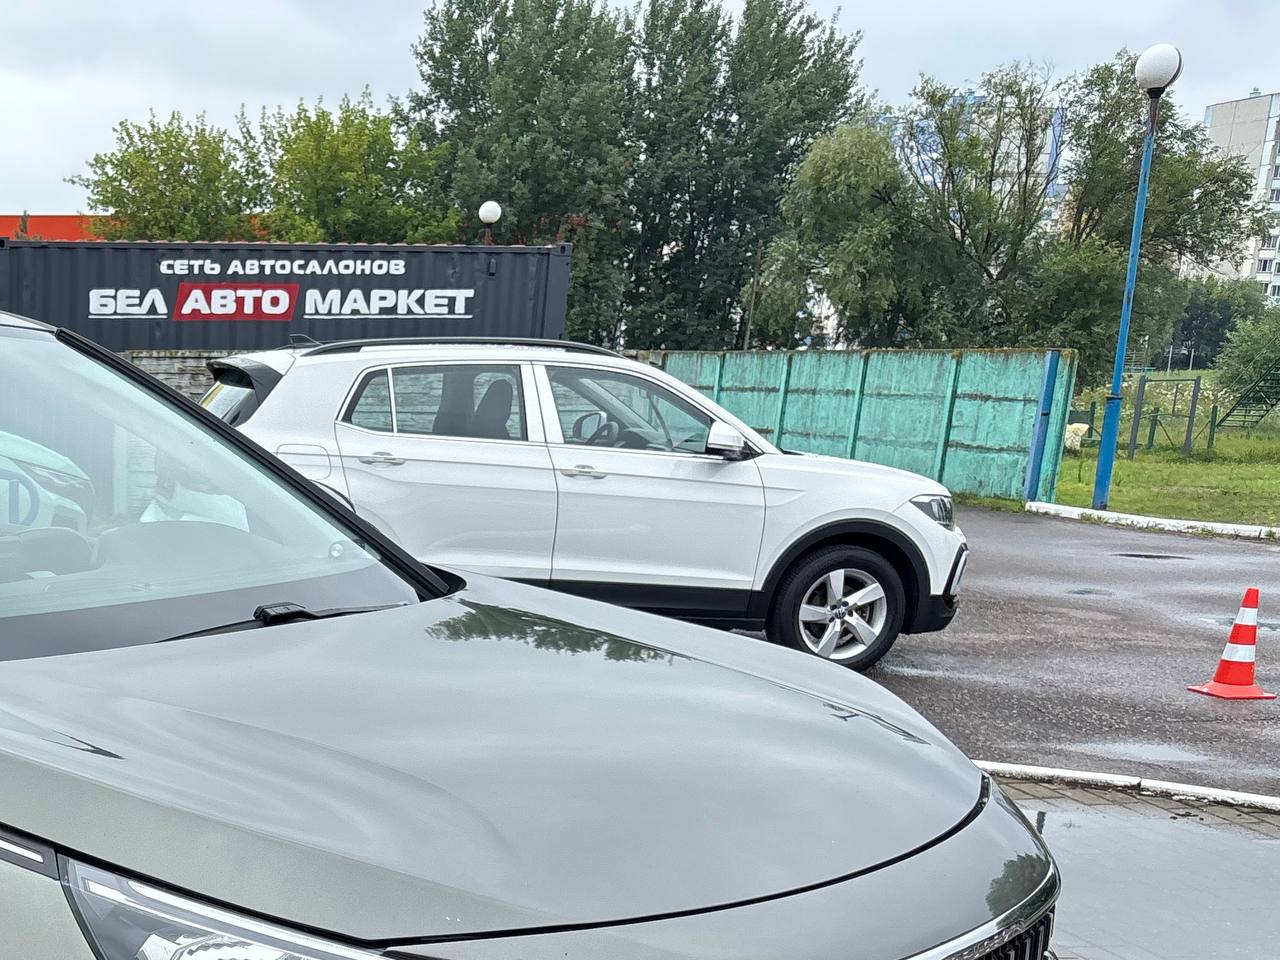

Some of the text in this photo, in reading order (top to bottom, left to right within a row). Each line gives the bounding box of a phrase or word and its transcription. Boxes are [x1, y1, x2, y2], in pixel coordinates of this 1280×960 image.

[160, 259, 406, 275] СЕТЬ АВТОСАЛОНОВ
[89, 288, 475, 315] БЕЛ АВТО МАРКЕТ
